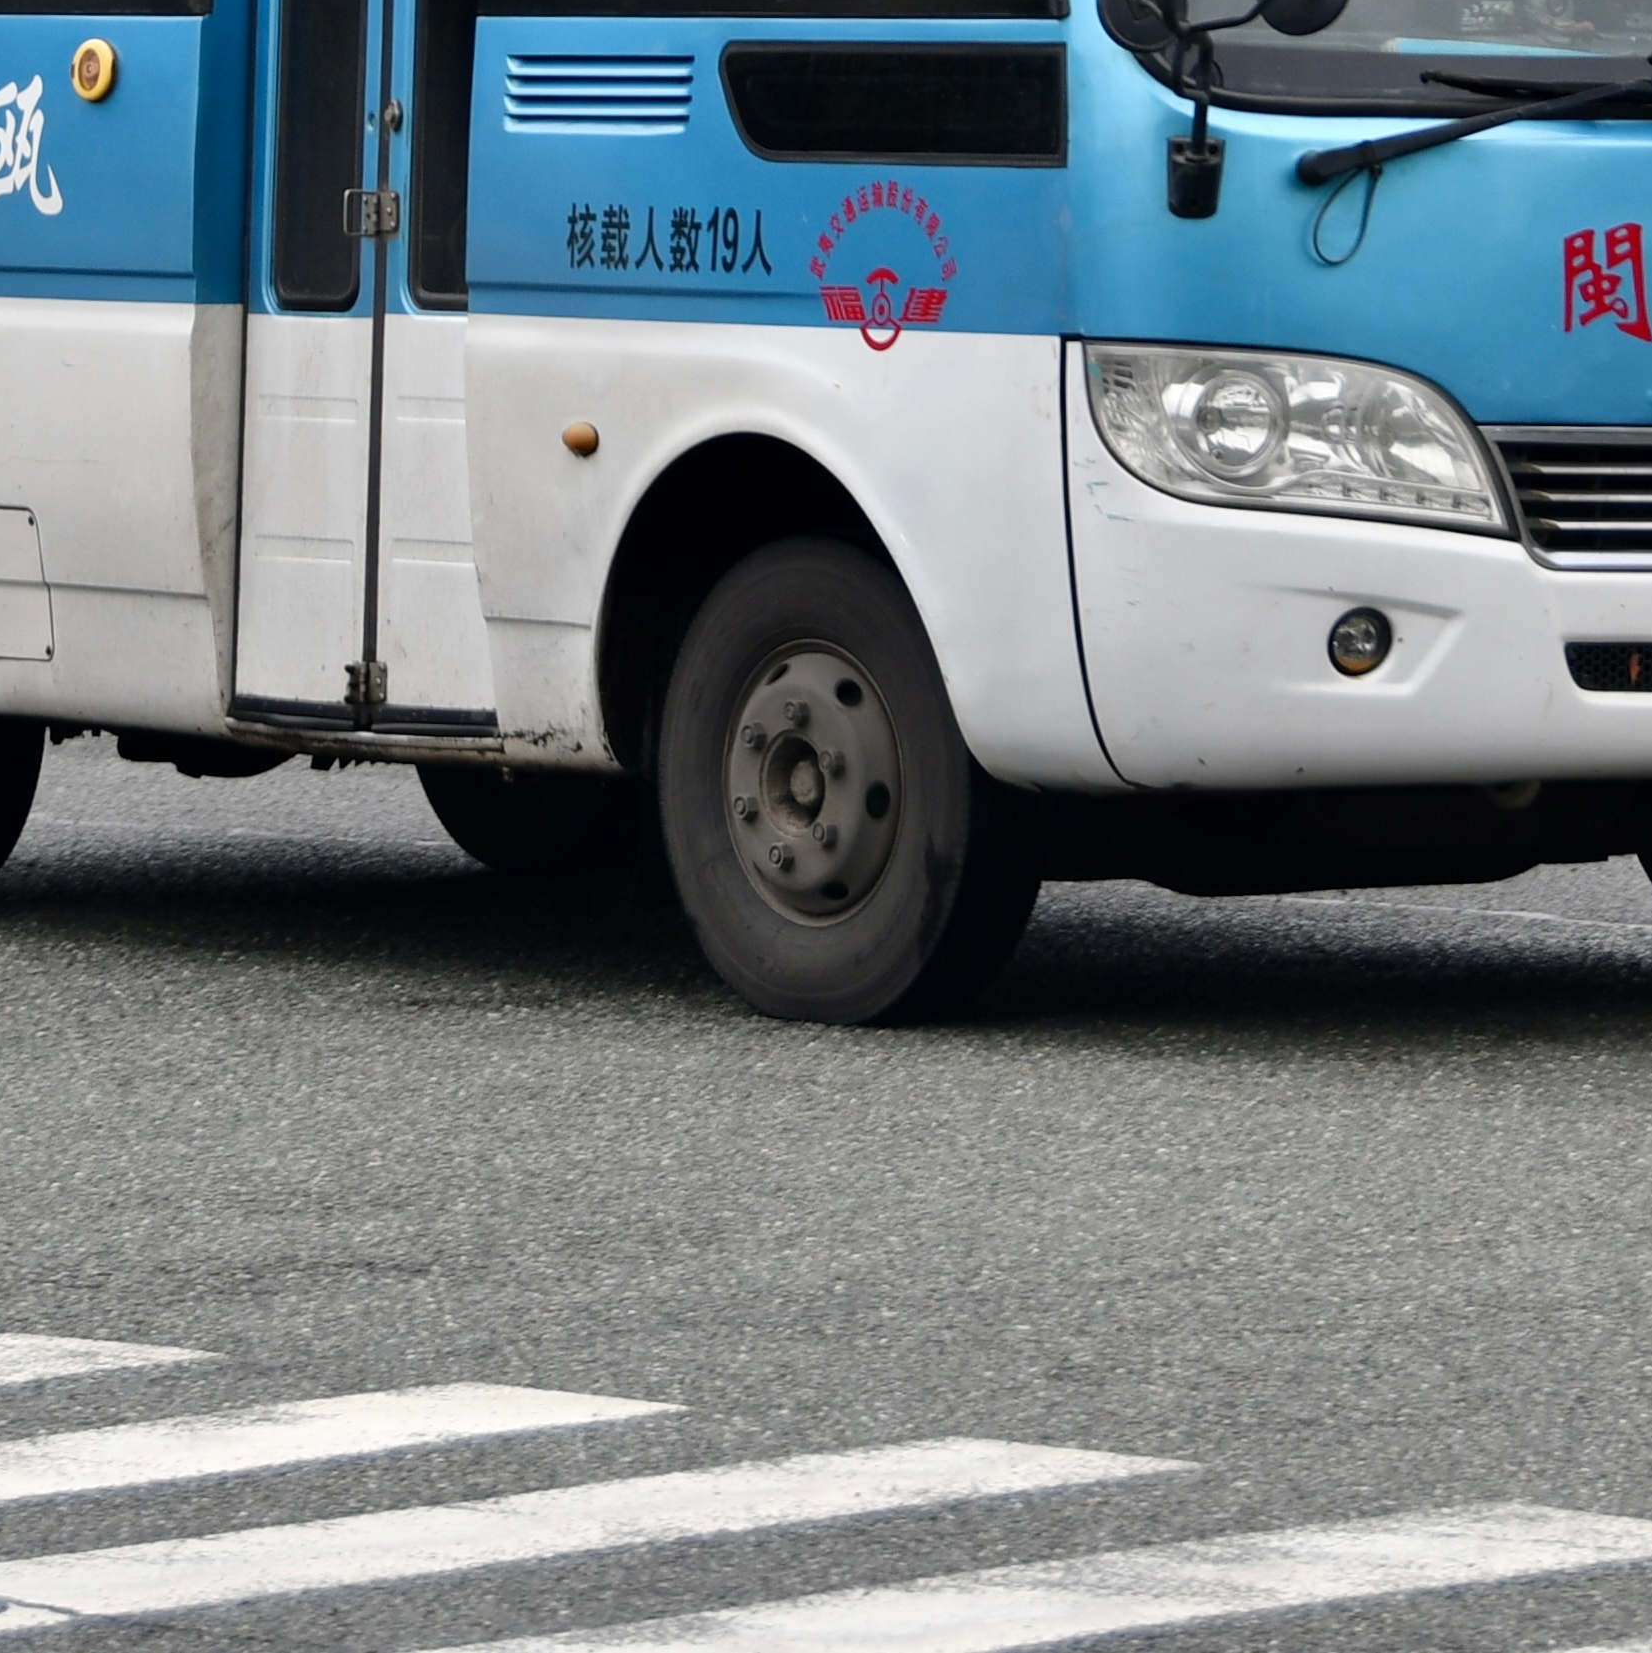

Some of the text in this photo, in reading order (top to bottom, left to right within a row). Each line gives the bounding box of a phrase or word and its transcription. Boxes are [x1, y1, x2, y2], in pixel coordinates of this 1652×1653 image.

[566, 203, 773, 276] 核载人数19人
